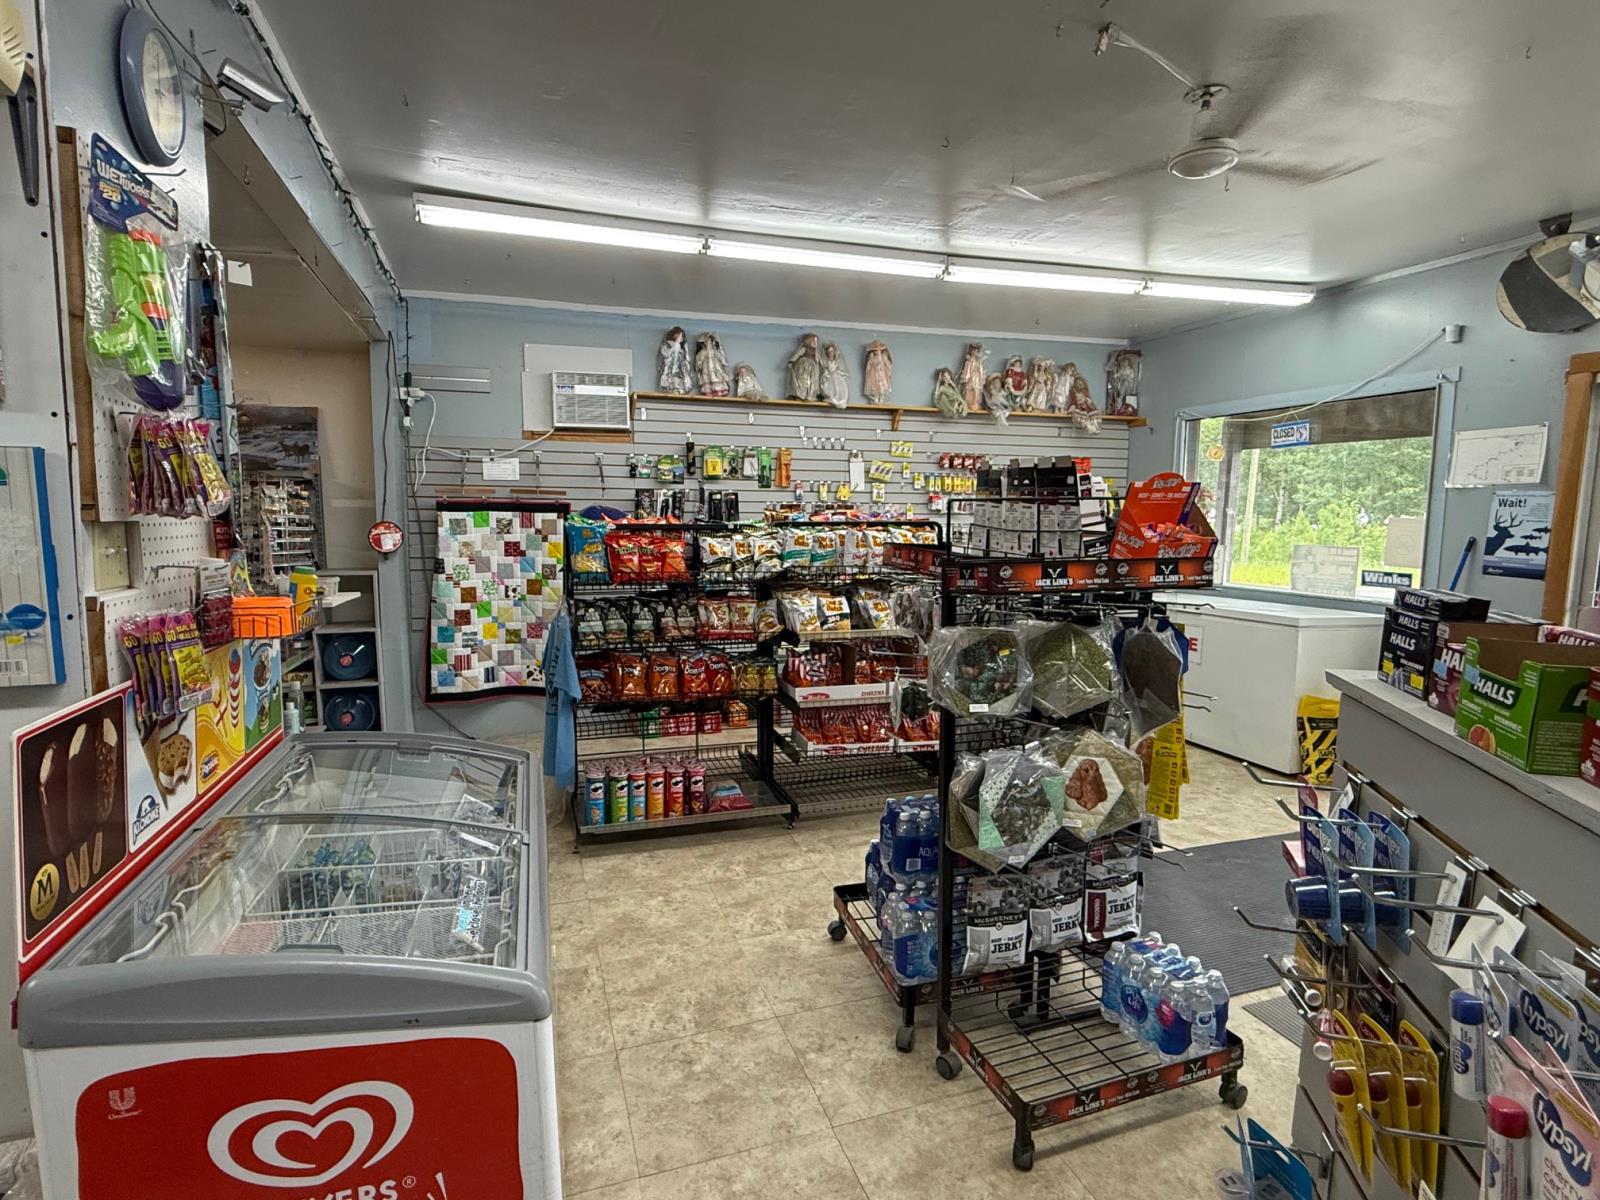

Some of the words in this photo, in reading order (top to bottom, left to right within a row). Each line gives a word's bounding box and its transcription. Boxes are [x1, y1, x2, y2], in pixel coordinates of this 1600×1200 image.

[1273, 426, 1295, 440] CLOSED
[158, 438, 174, 449] 60
[1498, 498, 1527, 508] Wait!
[1035, 578, 1051, 586] JACK
[1052, 577, 1073, 586] LINK'S
[1165, 574, 1184, 582] LINK'S
[1364, 572, 1410, 585] Winks
[1404, 594, 1426, 607] HALLS
[1398, 615, 1419, 629] HALLS
[124, 636, 139, 648] 60
[167, 630, 177, 641] 60
[1389, 632, 1416, 651] HALLS
[652, 665, 676, 674] Doritos
[1473, 677, 1516, 705] HALLS
[133, 804, 160, 844] KLONDIKE
[1108, 900, 1134, 914] JERKY
[470, 908, 482, 929] close
[991, 938, 1023, 954] JERKY
[1524, 996, 1569, 1050] Lypsyl
[1178, 1073, 1192, 1082] JACK
[1193, 1068, 1212, 1079] LINK'S
[1068, 1105, 1084, 1115] JACK
[1085, 1099, 1105, 1112] LINK'S
[1537, 1100, 1592, 1172] Lypsyl
